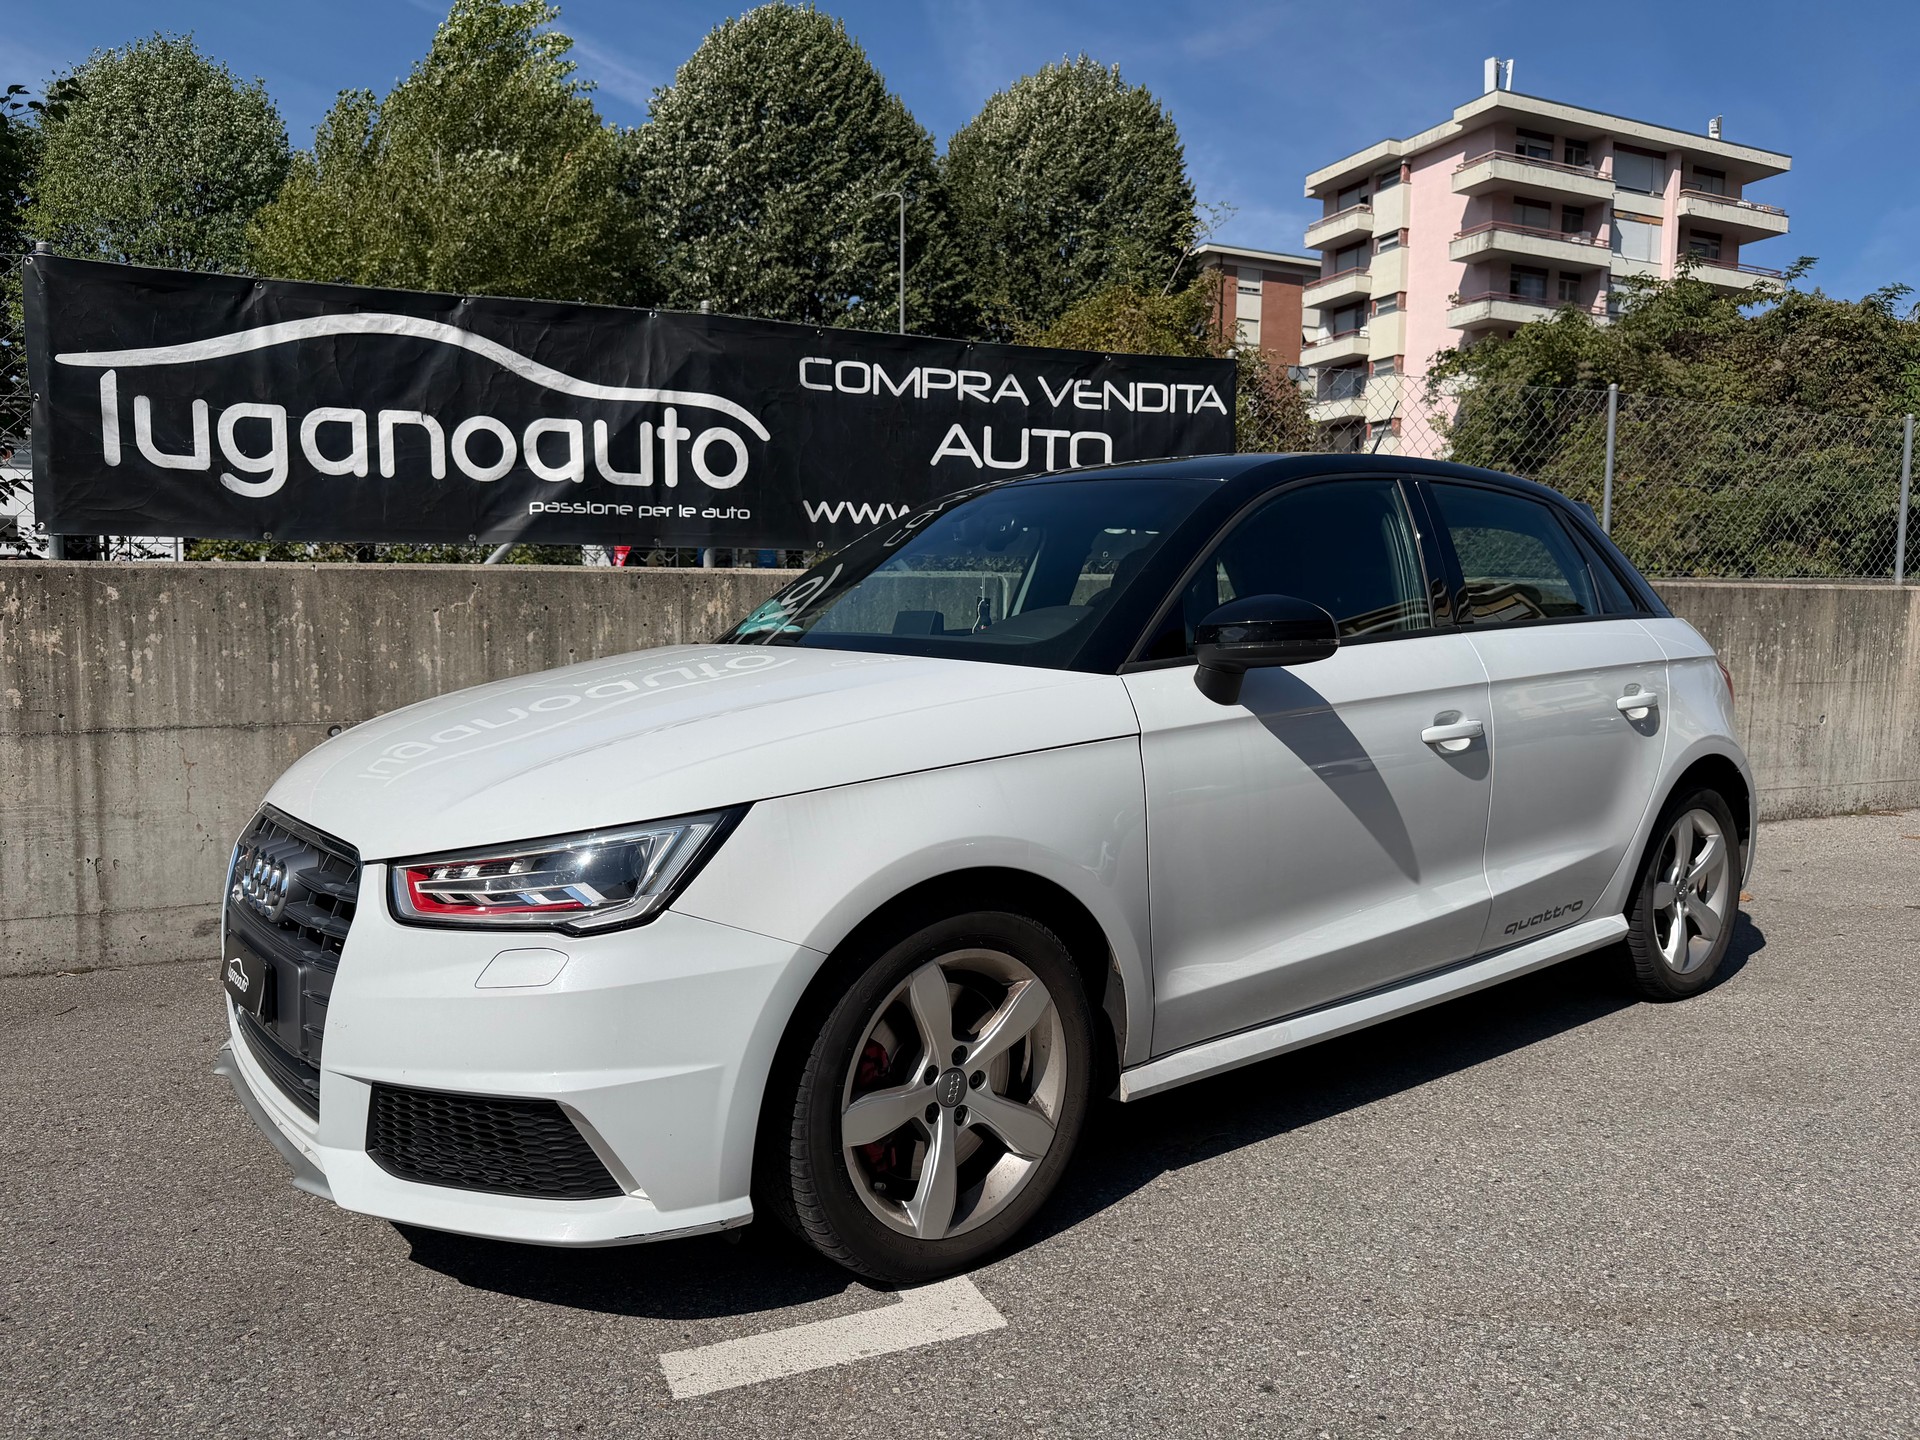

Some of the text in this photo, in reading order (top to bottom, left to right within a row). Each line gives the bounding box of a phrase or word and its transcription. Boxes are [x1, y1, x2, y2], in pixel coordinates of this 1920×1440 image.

[798, 356, 1228, 415] COMPRA VENDITA
[99, 368, 750, 498] luganoauto
[929, 423, 1113, 472] AUTO
[528, 501, 751, 520] passione per le auto
[1503, 900, 1584, 935] quattro
